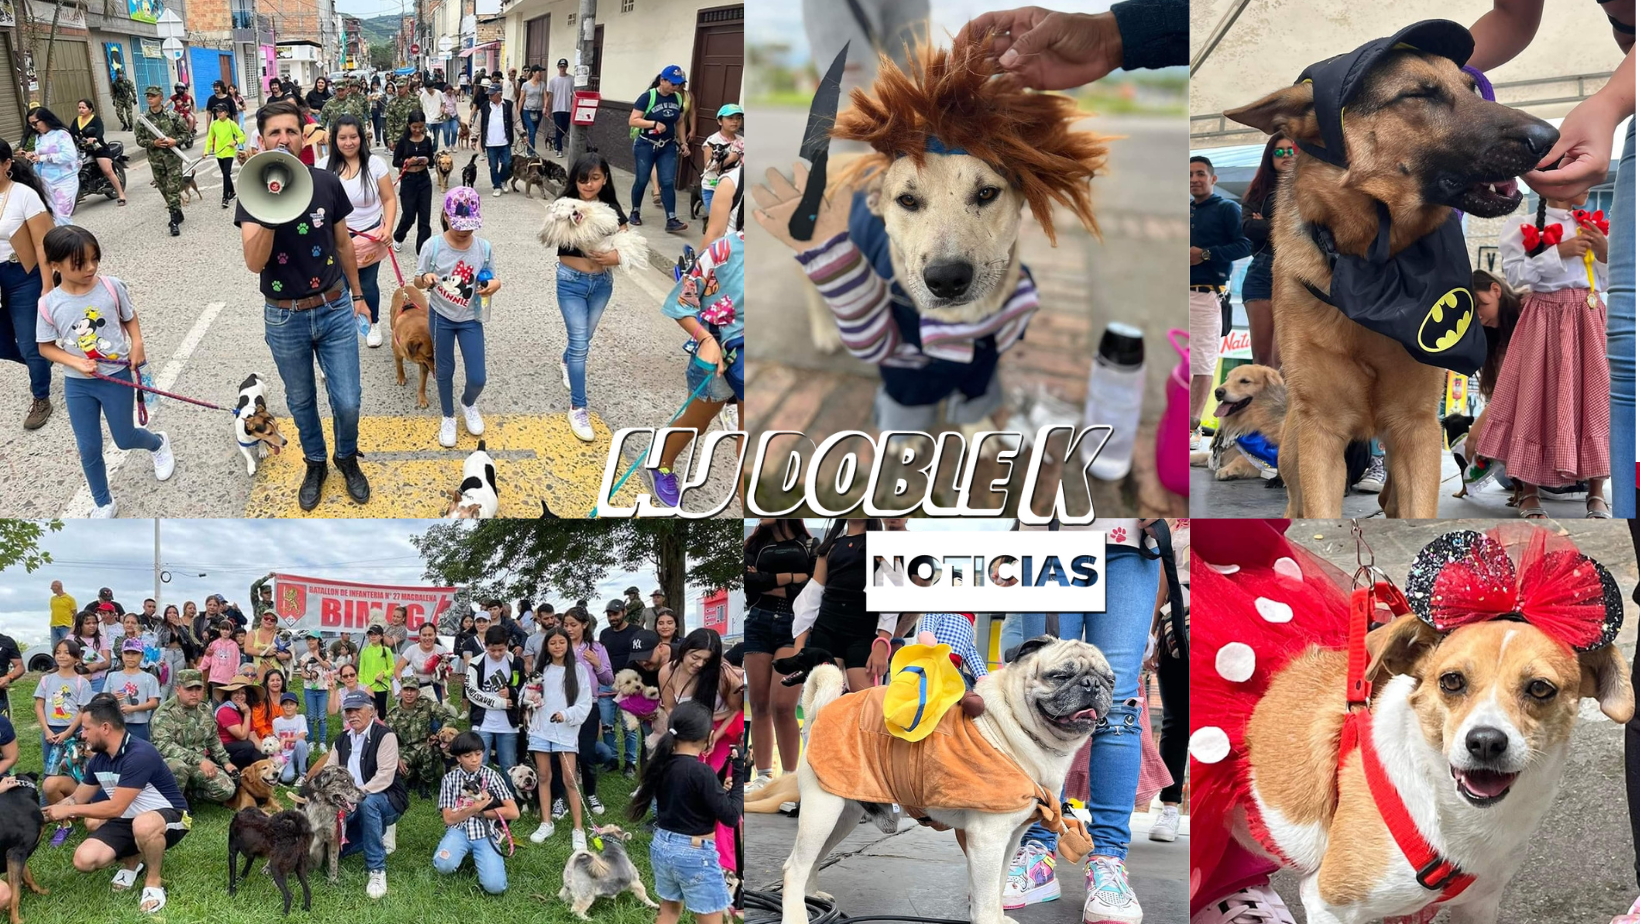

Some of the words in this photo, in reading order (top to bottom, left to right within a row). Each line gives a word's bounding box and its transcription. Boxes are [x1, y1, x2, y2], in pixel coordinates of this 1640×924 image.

[437, 284, 470, 307] MINNIE
[309, 585, 340, 596] BATALLON
[340, 588, 348, 597] DE
[349, 589, 384, 599] INFANTERIA
[393, 592, 400, 600] 27
[401, 593, 437, 602] MAGDALENA
